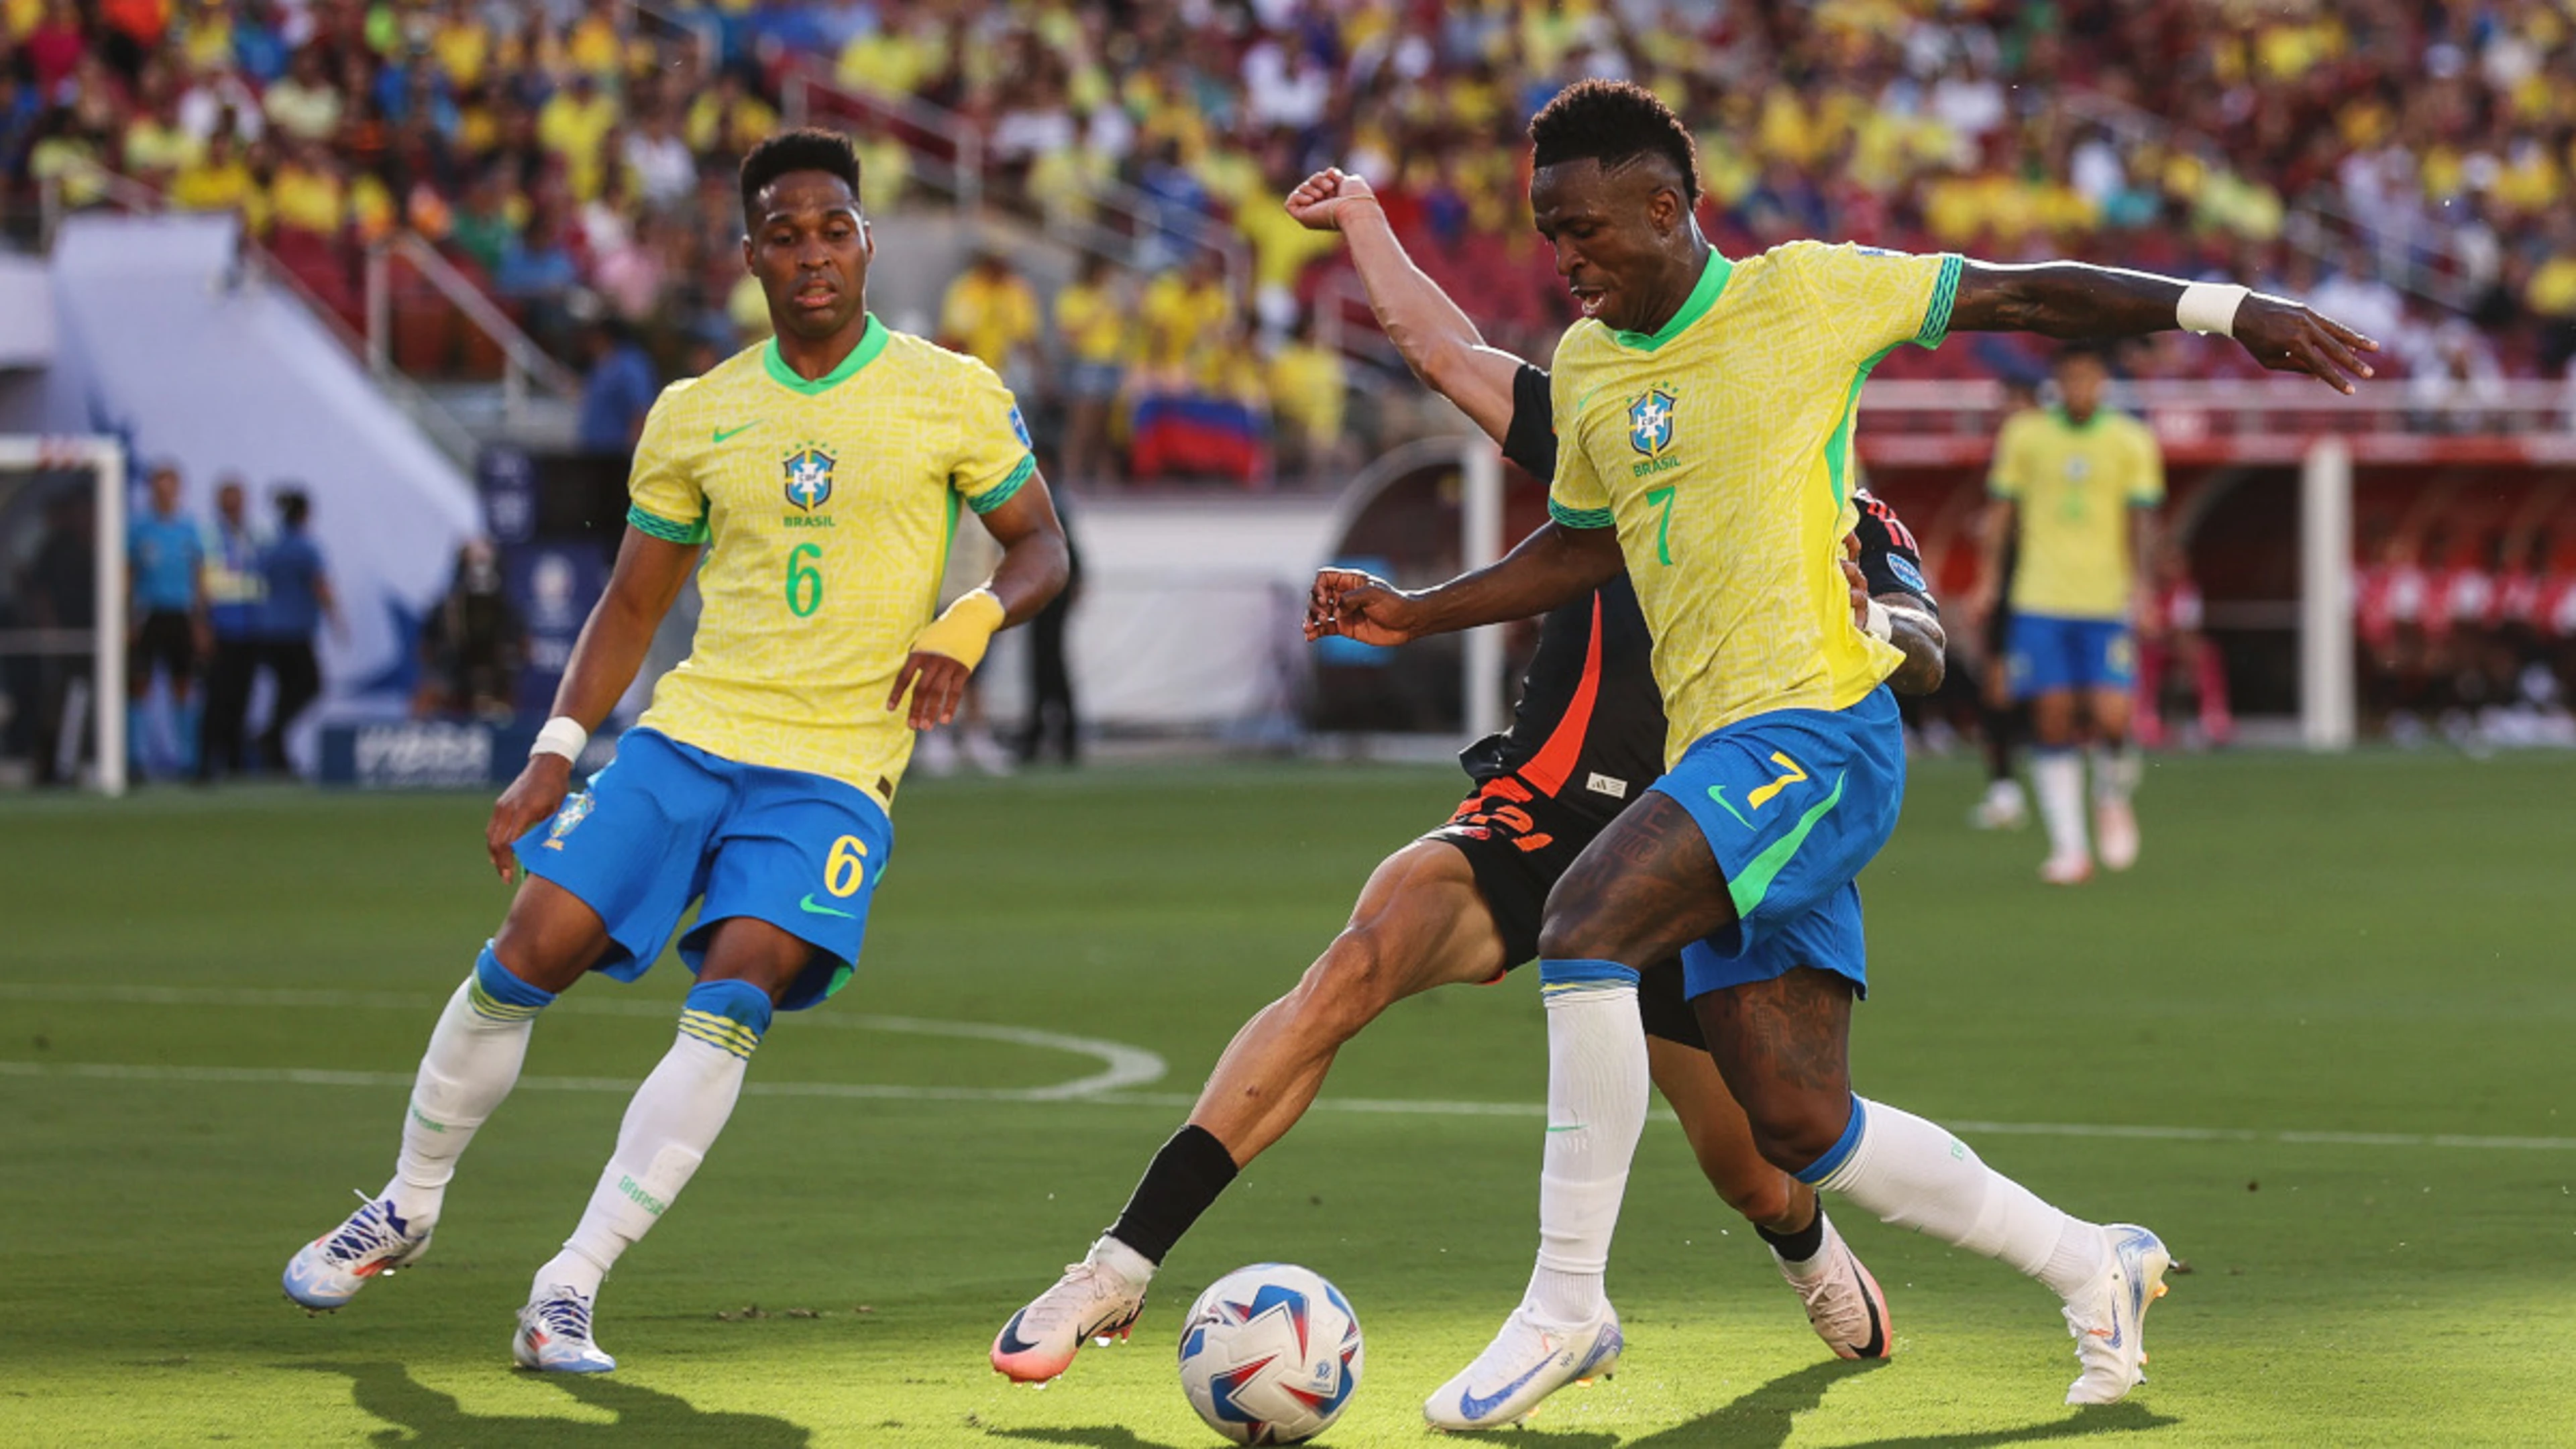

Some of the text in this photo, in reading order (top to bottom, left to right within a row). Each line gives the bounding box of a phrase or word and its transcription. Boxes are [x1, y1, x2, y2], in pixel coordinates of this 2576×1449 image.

[1633, 455, 1681, 478] BRASIL
[784, 517, 837, 528] BRASIL
[1646, 484, 1676, 566] 7
[786, 542, 823, 618] 6
[1747, 751, 1808, 810] 7
[824, 835, 868, 898] 6
